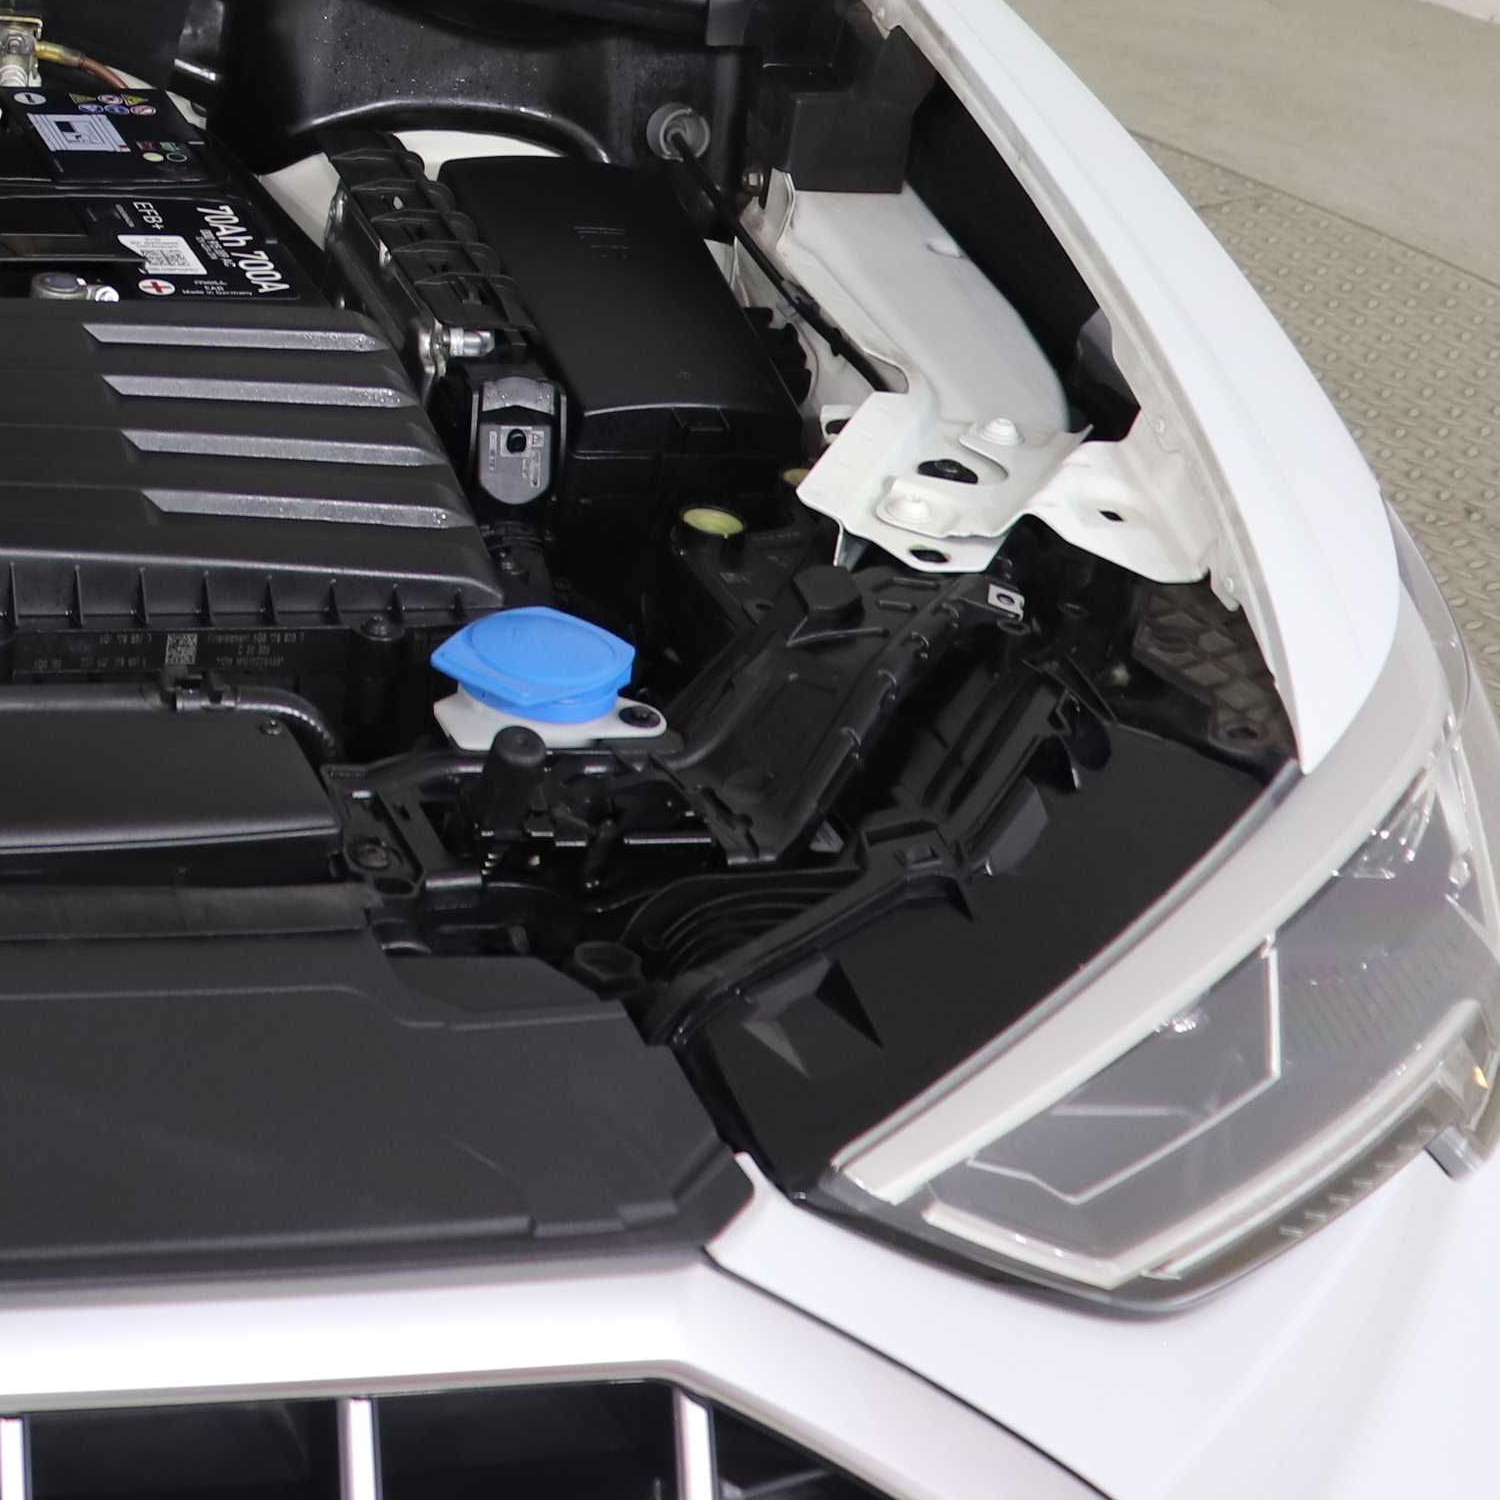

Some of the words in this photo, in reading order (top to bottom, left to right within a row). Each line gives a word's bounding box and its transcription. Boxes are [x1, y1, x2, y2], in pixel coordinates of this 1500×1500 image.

[132, 202, 164, 230] EFB+
[196, 205, 253, 247] 70Ah
[230, 250, 290, 293] 700A
